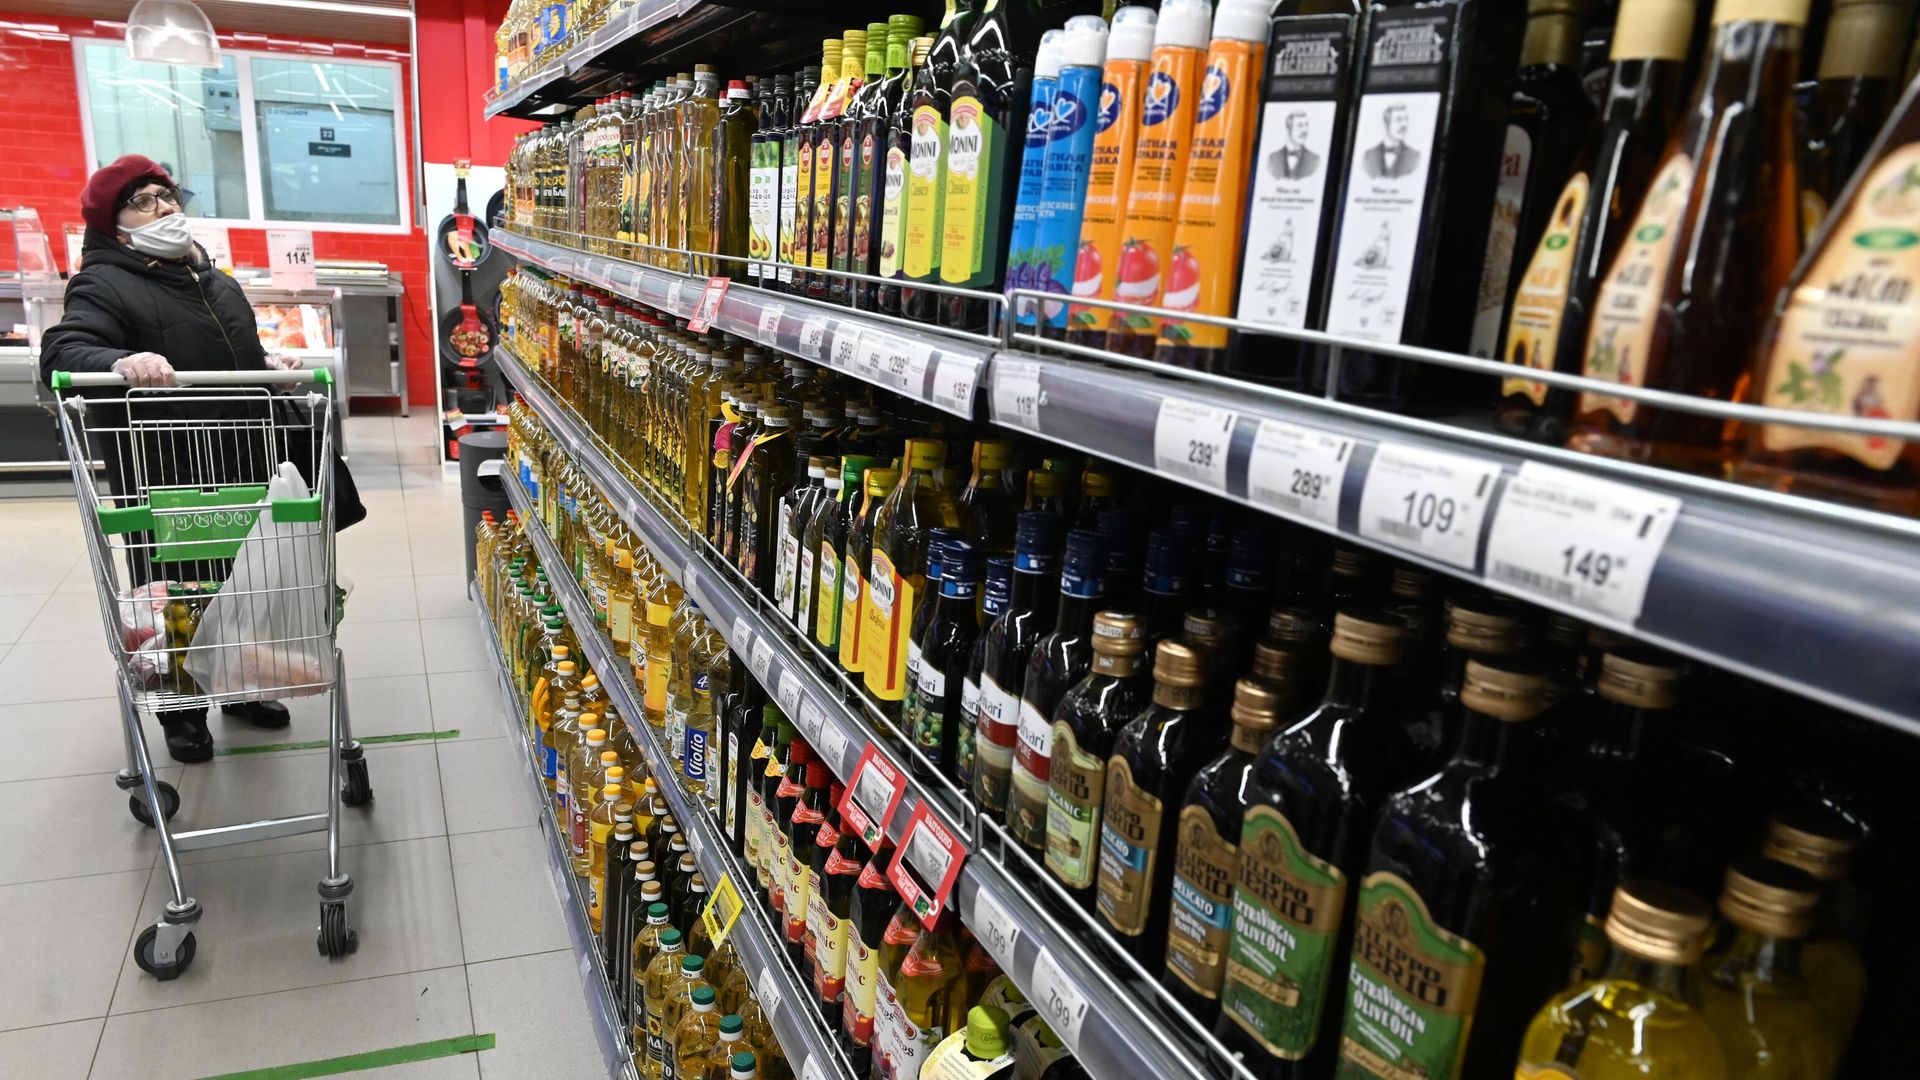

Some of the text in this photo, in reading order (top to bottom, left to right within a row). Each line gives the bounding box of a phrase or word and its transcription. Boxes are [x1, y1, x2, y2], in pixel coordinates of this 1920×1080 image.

[286, 251, 306, 264] 114
[765, 417, 786, 426] Altero
[1188, 440, 1213, 467] 239
[1291, 468, 1322, 499] 289
[1402, 490, 1455, 533] 109
[1561, 545, 1612, 586] 149
[688, 733, 704, 776] Violio
[1172, 875, 1214, 917] DELICATO
[988, 921, 1006, 955] 799
[1049, 987, 1070, 1027] 799
